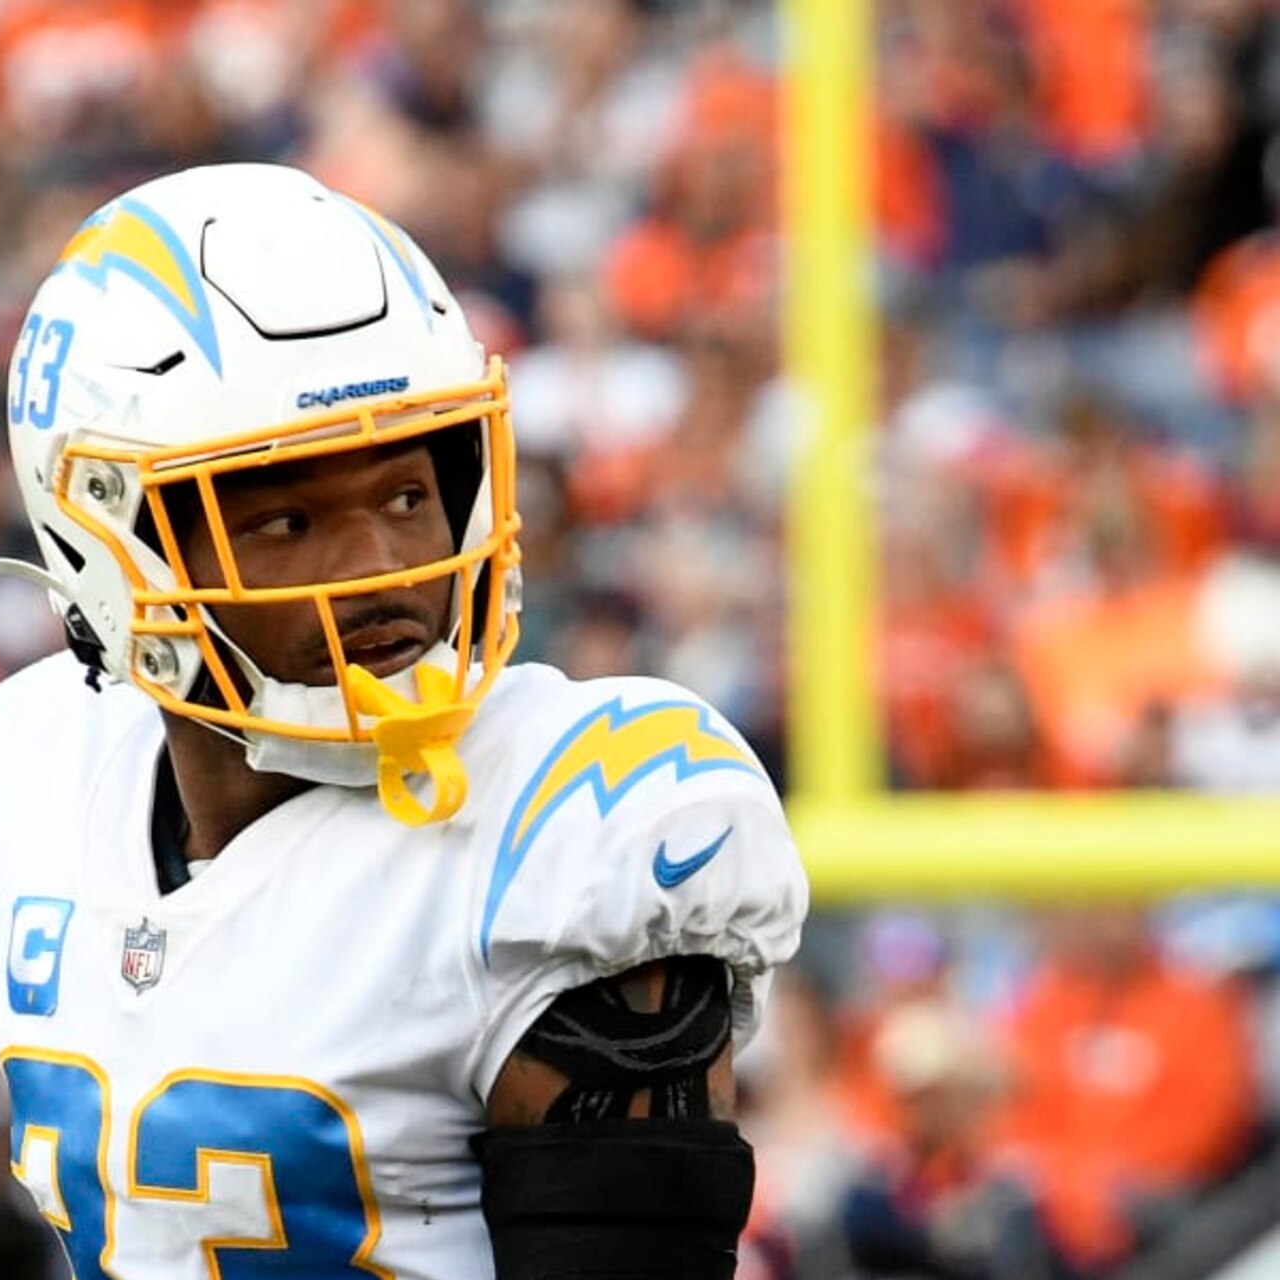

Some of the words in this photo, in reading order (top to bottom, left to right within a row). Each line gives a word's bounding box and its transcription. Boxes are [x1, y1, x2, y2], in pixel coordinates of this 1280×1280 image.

[10, 313, 74, 430] 33
[296, 376, 410, 409] CHARGERS
[10, 904, 63, 985] C
[123, 949, 153, 982] NFL
